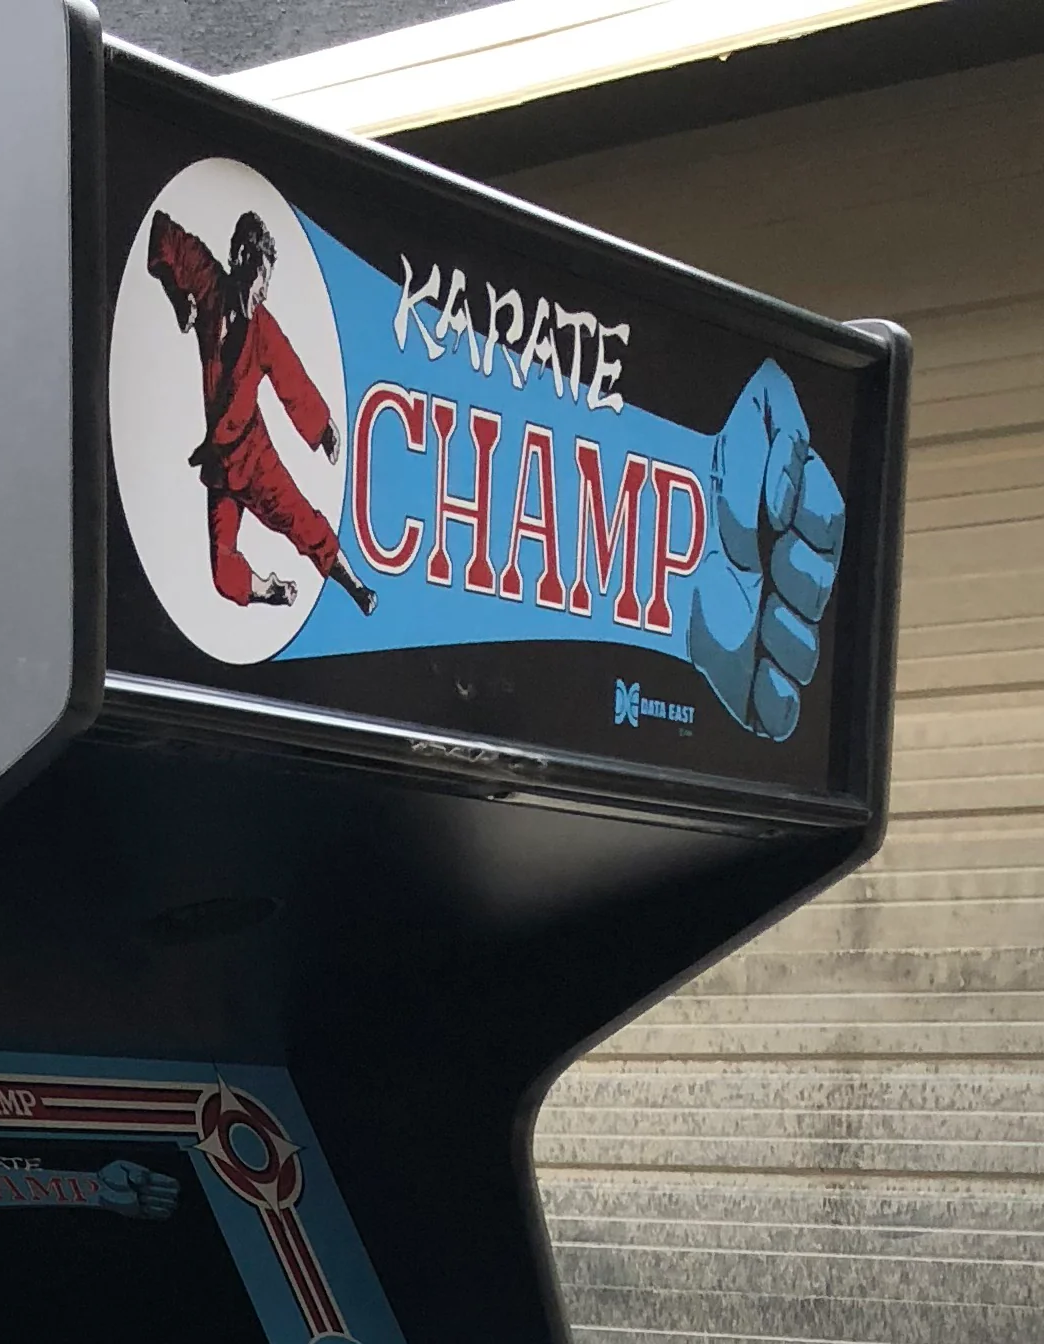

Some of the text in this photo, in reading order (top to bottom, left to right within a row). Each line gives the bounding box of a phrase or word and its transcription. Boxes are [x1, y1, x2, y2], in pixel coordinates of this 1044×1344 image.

[392, 253, 630, 413] KARATE
[355, 381, 706, 636] CHAMP
[641, 698, 695, 724] DATA EAST
